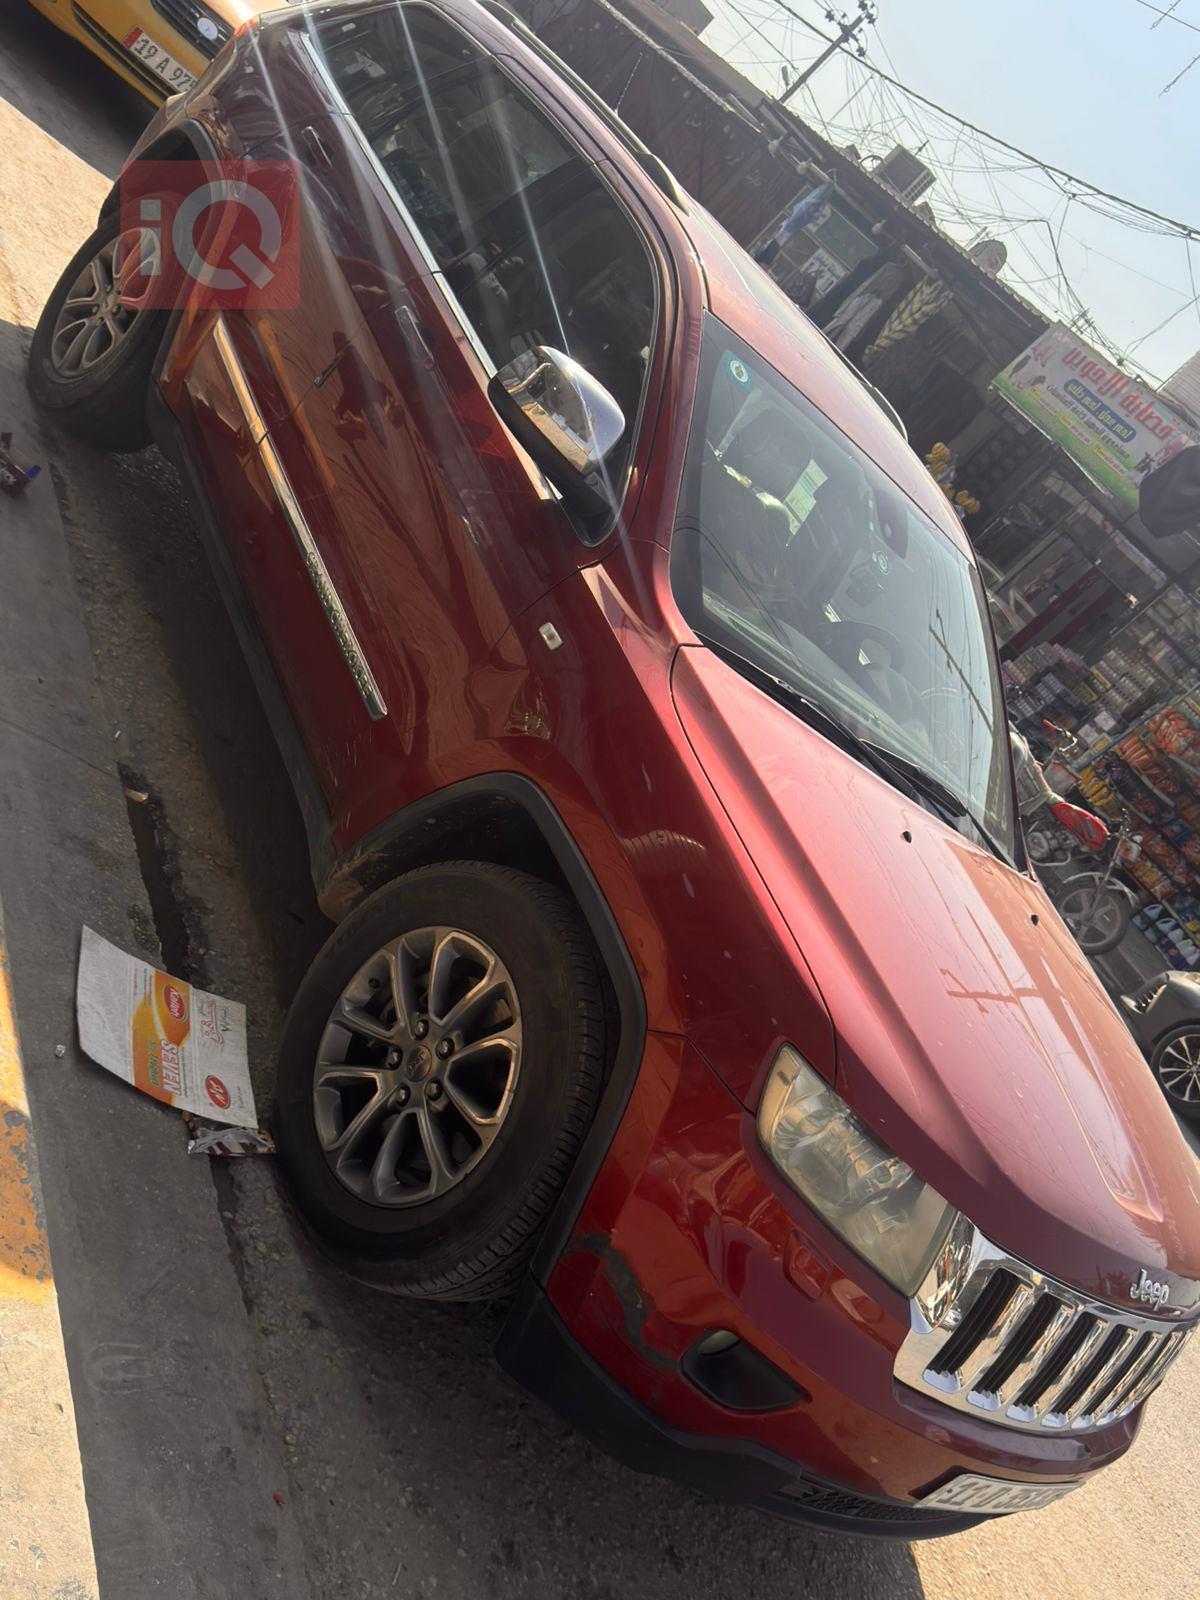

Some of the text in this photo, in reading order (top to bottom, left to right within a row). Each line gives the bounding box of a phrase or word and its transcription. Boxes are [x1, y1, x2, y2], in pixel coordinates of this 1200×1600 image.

[134, 38, 158, 60] 19
[155, 57, 170, 74] A
[1119, 387, 1181, 442] قصابة
[160, 1038, 182, 1096] SEVEN
[1130, 1268, 1169, 1312] Jeep
